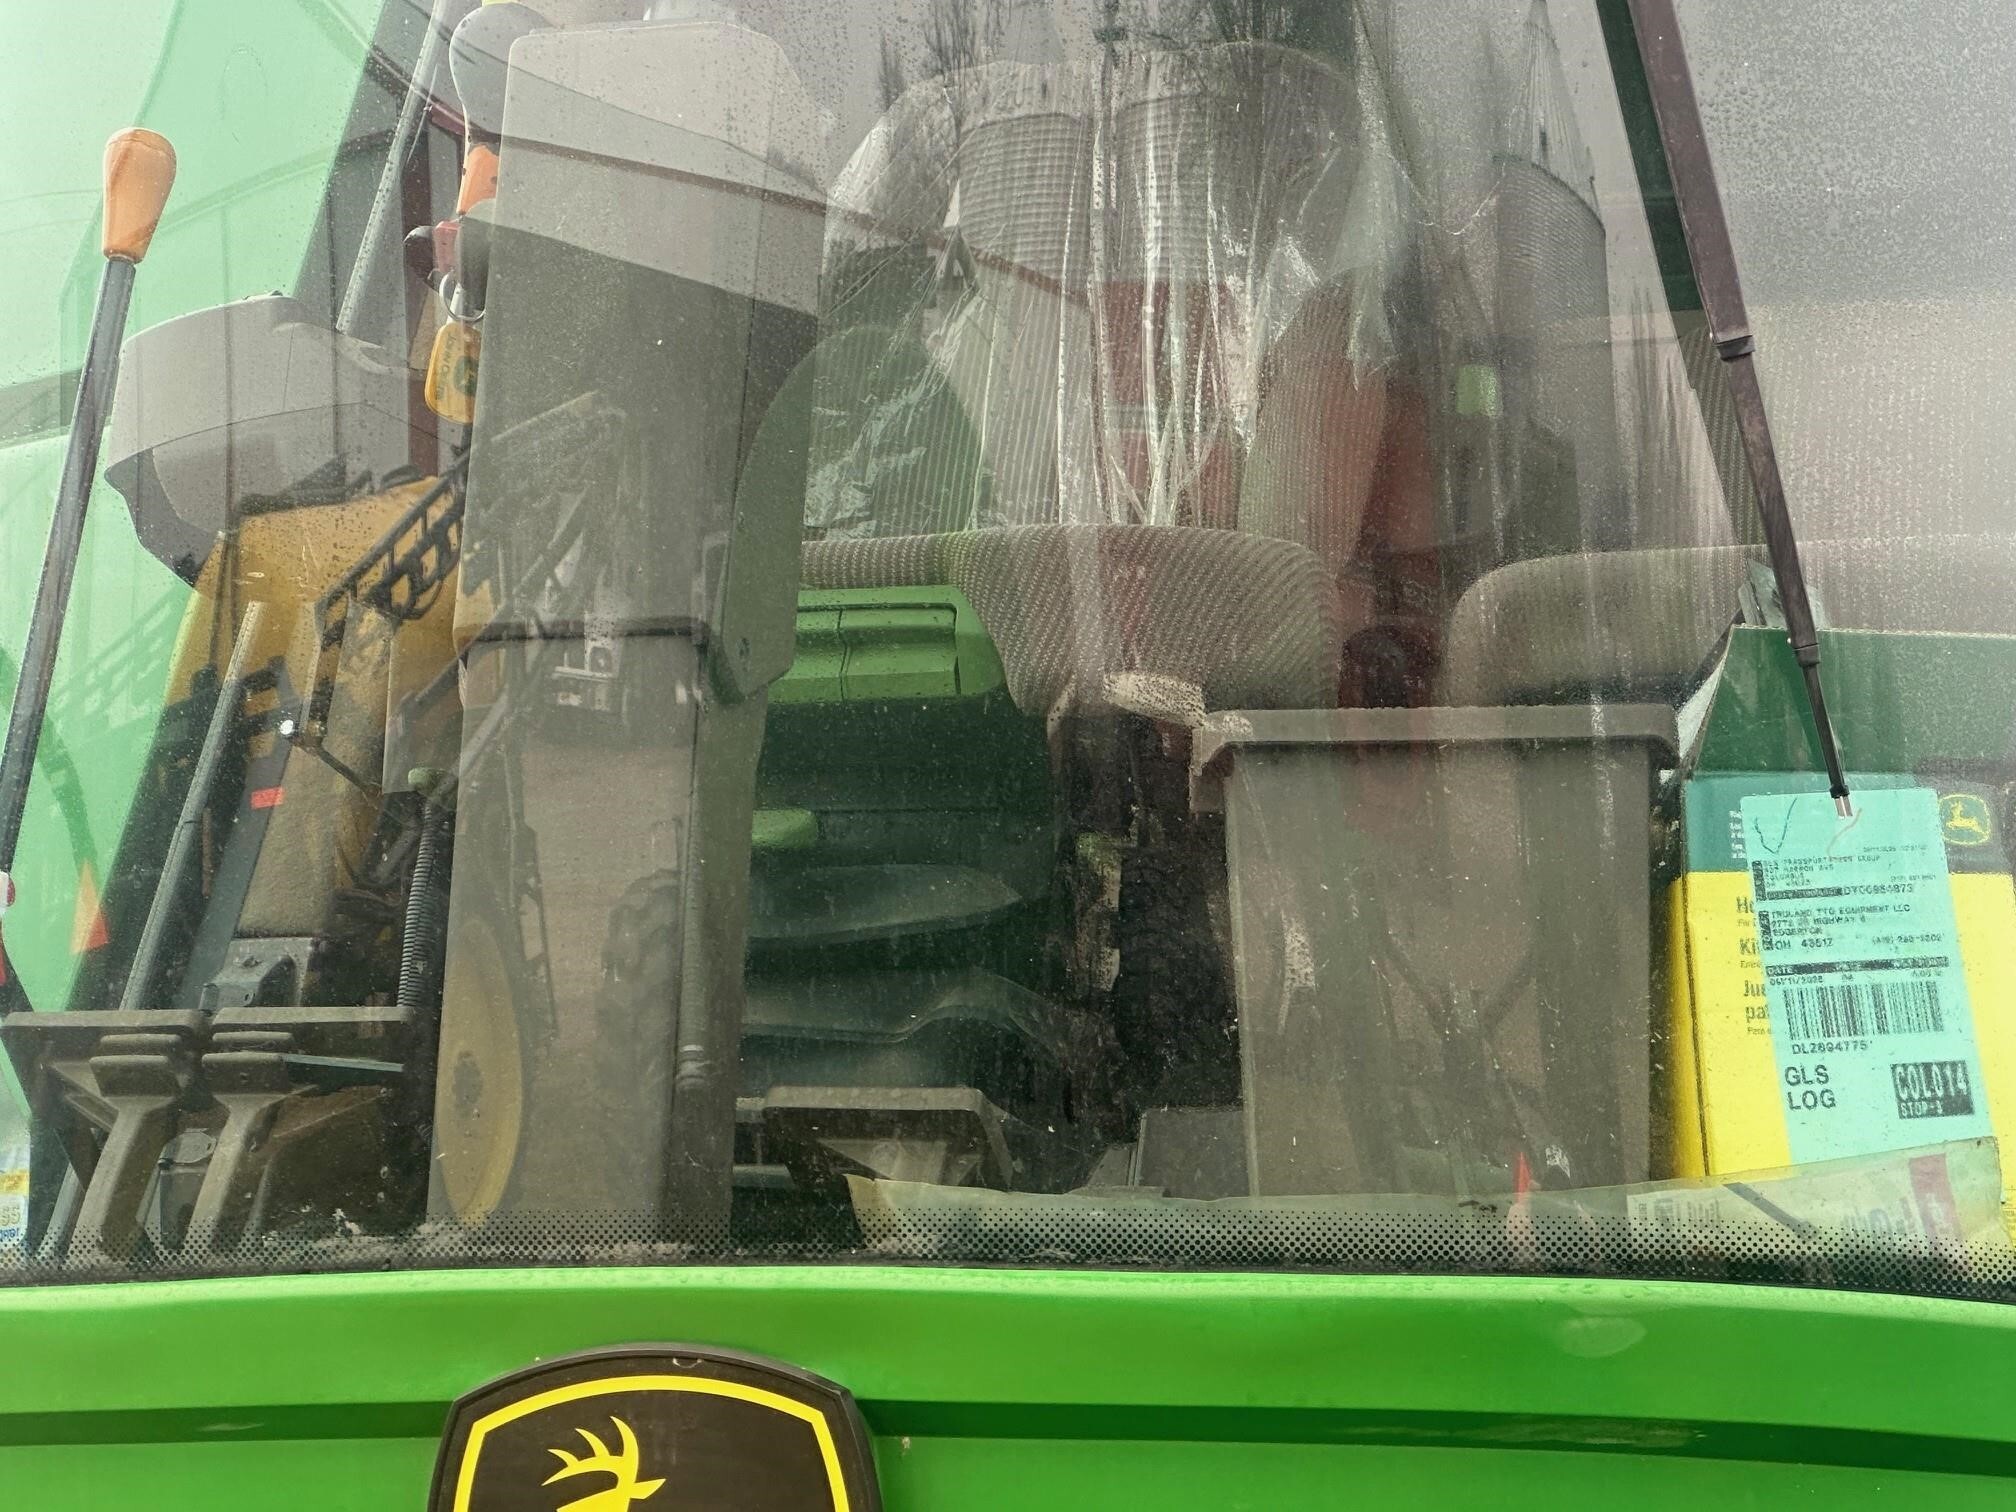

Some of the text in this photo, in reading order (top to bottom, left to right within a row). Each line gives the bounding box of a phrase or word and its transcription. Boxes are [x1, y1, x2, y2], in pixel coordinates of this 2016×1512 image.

[1893, 904, 1911, 912] LLC
[1785, 1064, 1829, 1086] GLS
[1788, 1089, 1836, 1110] LOG
